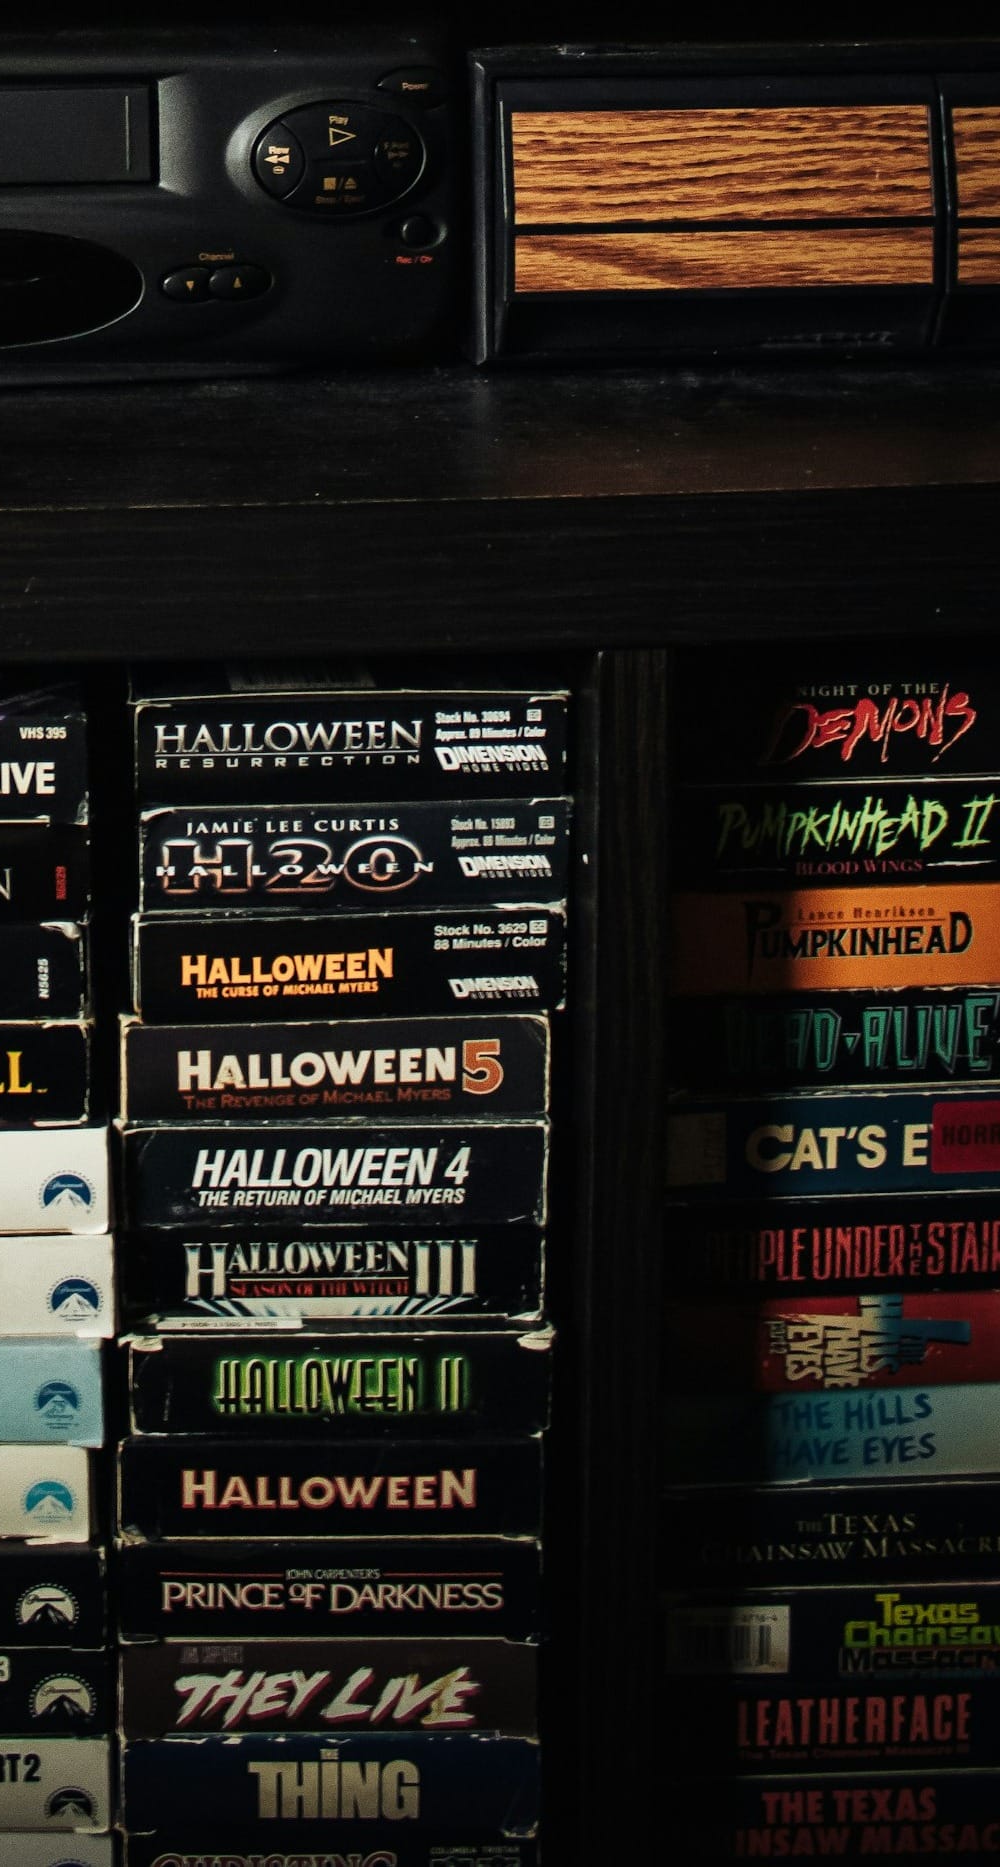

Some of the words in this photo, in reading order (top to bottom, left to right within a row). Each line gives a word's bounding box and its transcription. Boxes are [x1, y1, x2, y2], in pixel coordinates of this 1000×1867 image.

[867, 684, 893, 696] OF
[901, 682, 940, 695] THE
[19, 726, 43, 740] VHS
[45, 726, 68, 740] 395
[154, 721, 423, 754] HALLOWEEN
[155, 755, 422, 769] RESURRECTION
[186, 818, 254, 836] JAMIE
[265, 819, 303, 833] LEE
[313, 817, 400, 833] CURTIS
[794, 860, 860, 876] BLOOD
[863, 859, 924, 874] WINGS
[798, 906, 845, 921] Lance
[853, 905, 936, 919] Henriksen
[745, 902, 974, 961] PUMPKINHEAD
[180, 948, 395, 987] HALLOWEEN
[195, 987, 219, 999] THE
[221, 985, 260, 998] CURSE
[262, 984, 280, 996] OF
[282, 983, 336, 996] MICHAEL
[338, 981, 380, 994] MYERS
[176, 1047, 457, 1092] HALLOWEEN
[461, 1038, 505, 1095] 5
[182, 1093, 217, 1110] THE
[220, 1092, 296, 1109] REVENGE
[299, 1092, 320, 1106] OF
[322, 1089, 393, 1106] MICHAEL
[396, 1088, 452, 1103] MYERS
[191, 1147, 438, 1188] HALLOWEEN
[443, 1146, 472, 1185] 4
[197, 1190, 231, 1208] THE
[233, 1189, 300, 1207] RETURN
[304, 1189, 328, 1206] OF
[329, 1188, 402, 1206] MICHAEL
[405, 1187, 466, 1205] MYERS
[785, 1323, 825, 1383] EYES
[824, 1326, 868, 1389] HAVE
[772, 1402, 833, 1431] THE
[844, 1391, 933, 1430] HILLS
[772, 1438, 849, 1467] HAVE
[862, 1432, 937, 1466] EYES
[179, 1468, 480, 1511] HALLOWEEN
[823, 1511, 920, 1535] TEXAS
[160, 1581, 286, 1614] PRINCE
[288, 1582, 328, 1609] OF
[328, 1582, 505, 1615] DARKNESS
[873, 1592, 983, 1627] Texas
[736, 1692, 974, 1748] LEATHERFACE
[246, 1758, 422, 1820] THING
[761, 1789, 825, 1825] THE
[830, 1786, 938, 1823] TEXAS
